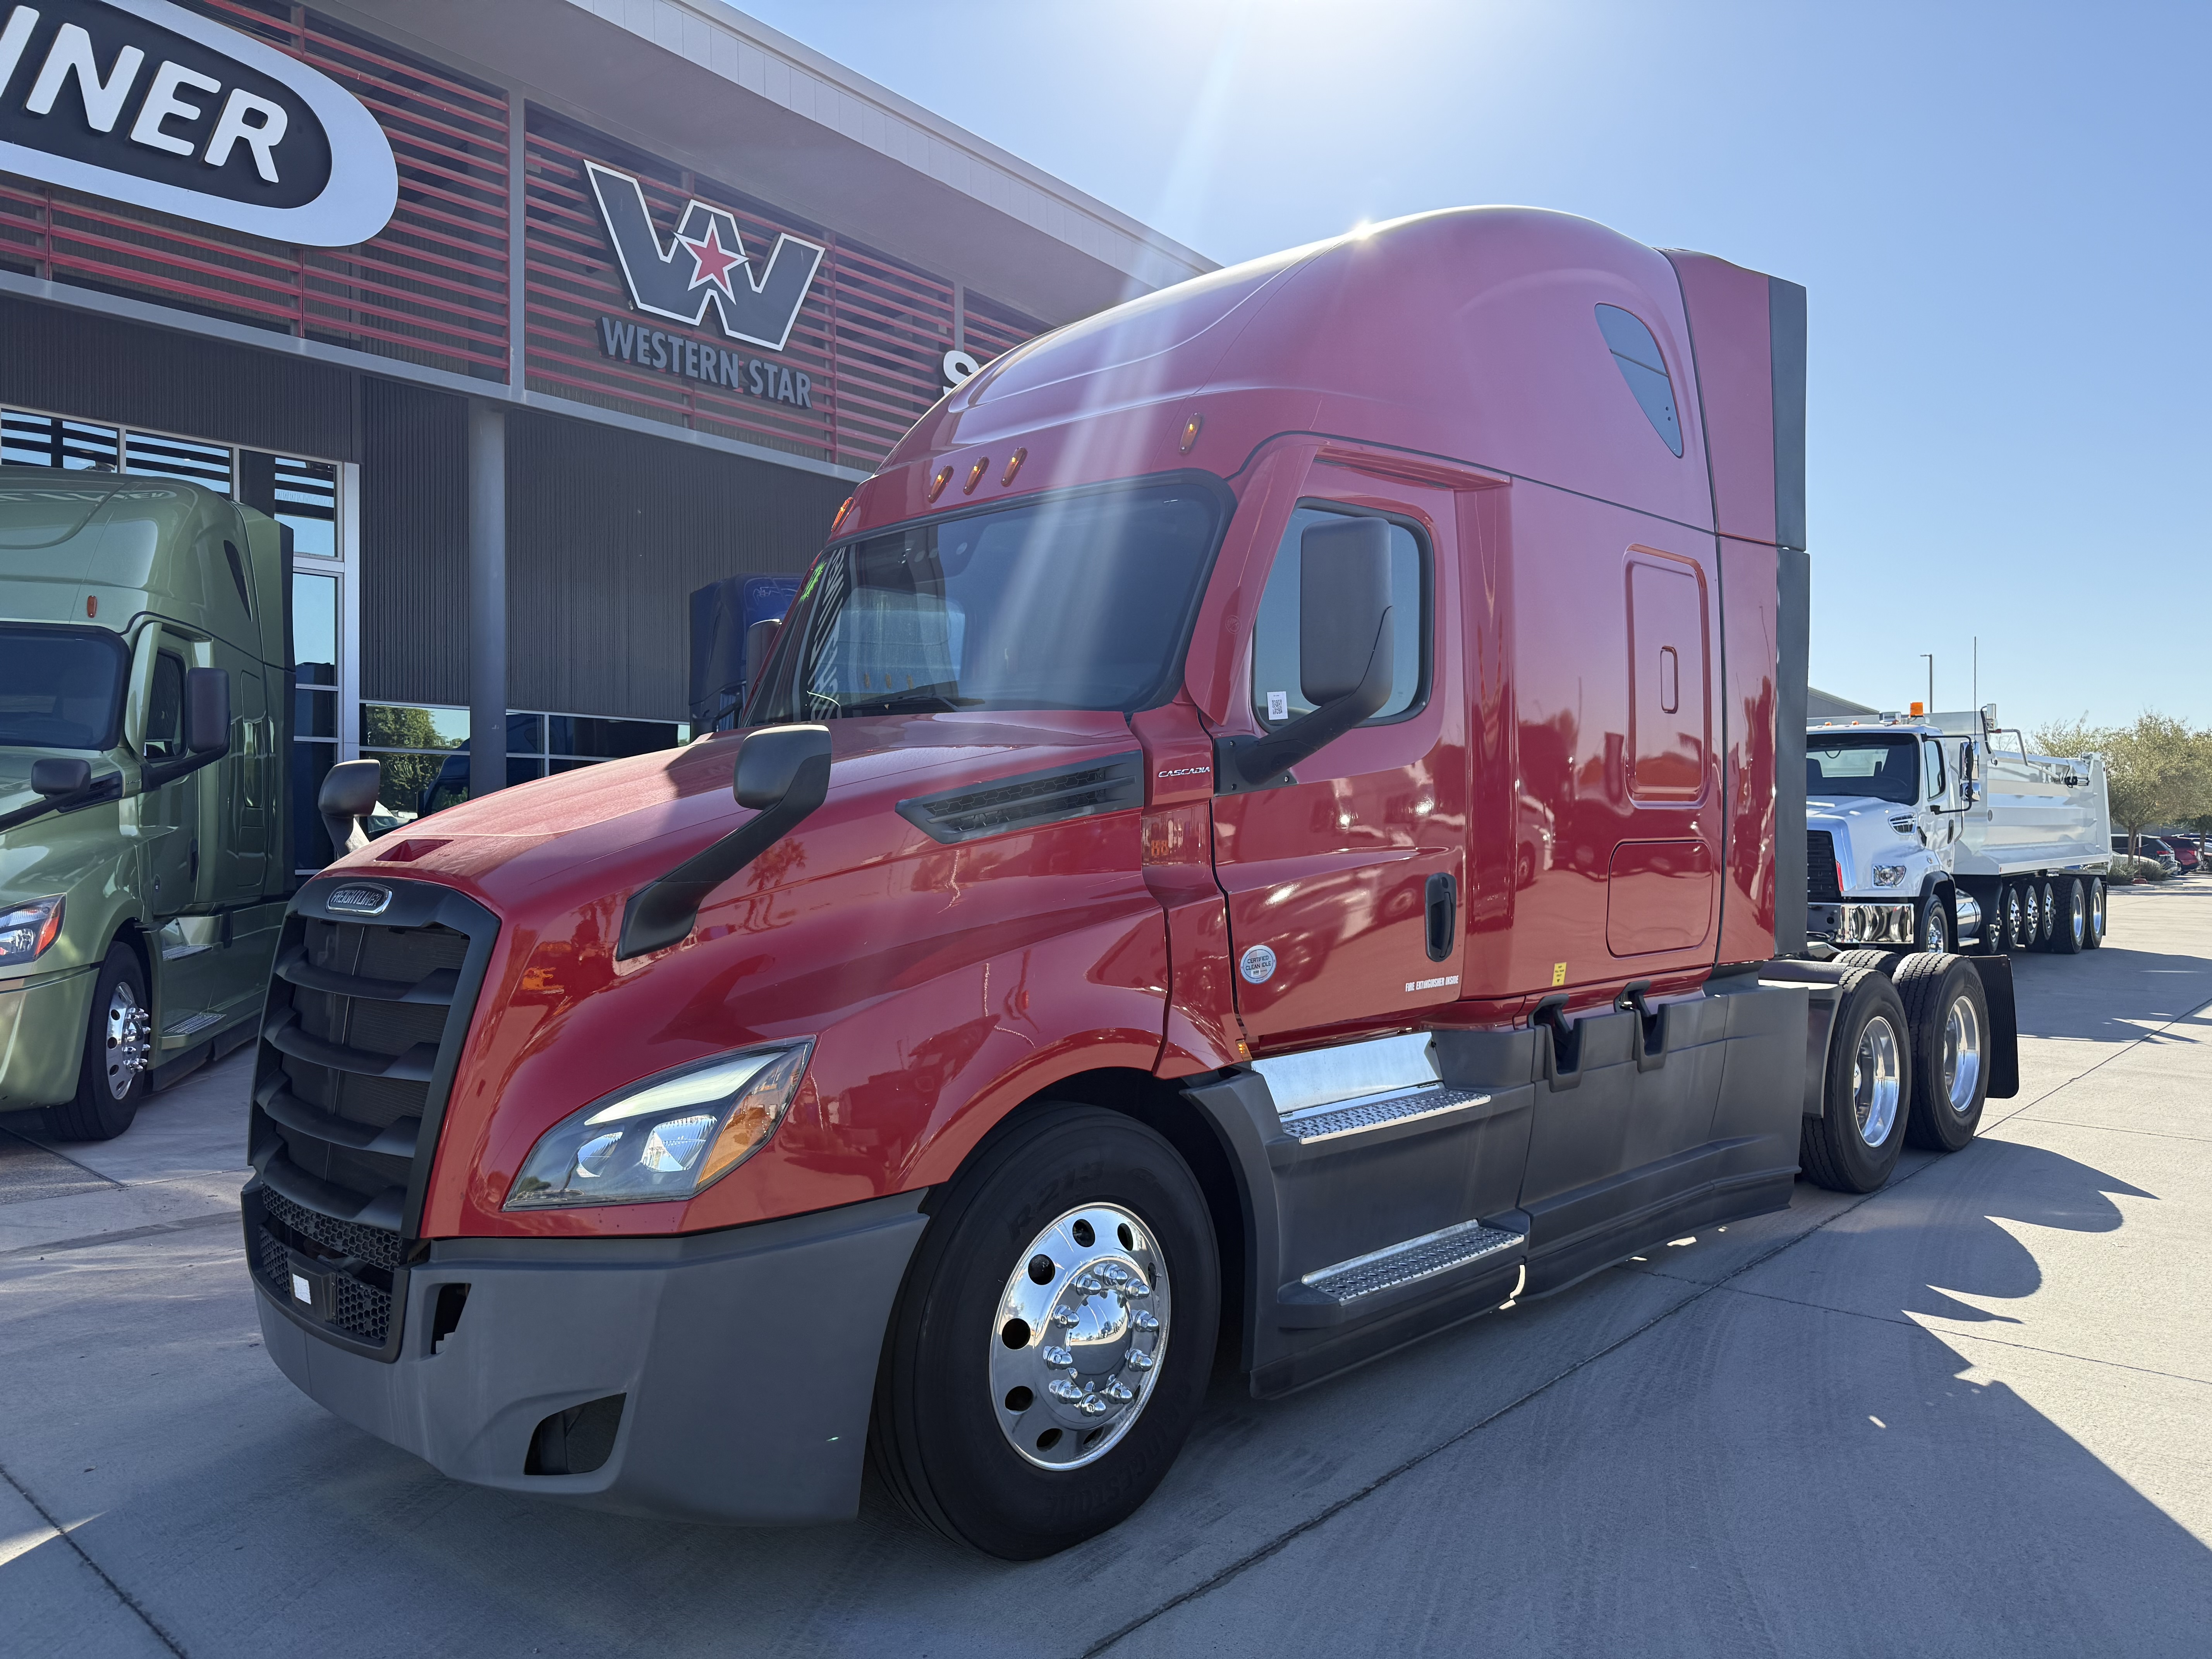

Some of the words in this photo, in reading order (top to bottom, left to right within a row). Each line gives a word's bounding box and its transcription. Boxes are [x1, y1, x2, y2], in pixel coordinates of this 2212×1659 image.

[601, 317, 740, 388] WESTERN
[748, 359, 812, 409] STAR
[1158, 766, 1210, 778] CASCADIA
[331, 890, 382, 906] FREIGHTLINER
[1405, 982, 1415, 992] FIRE
[1416, 977, 1444, 990] EXTINGUISHER
[1445, 975, 1459, 985] INSIDE
